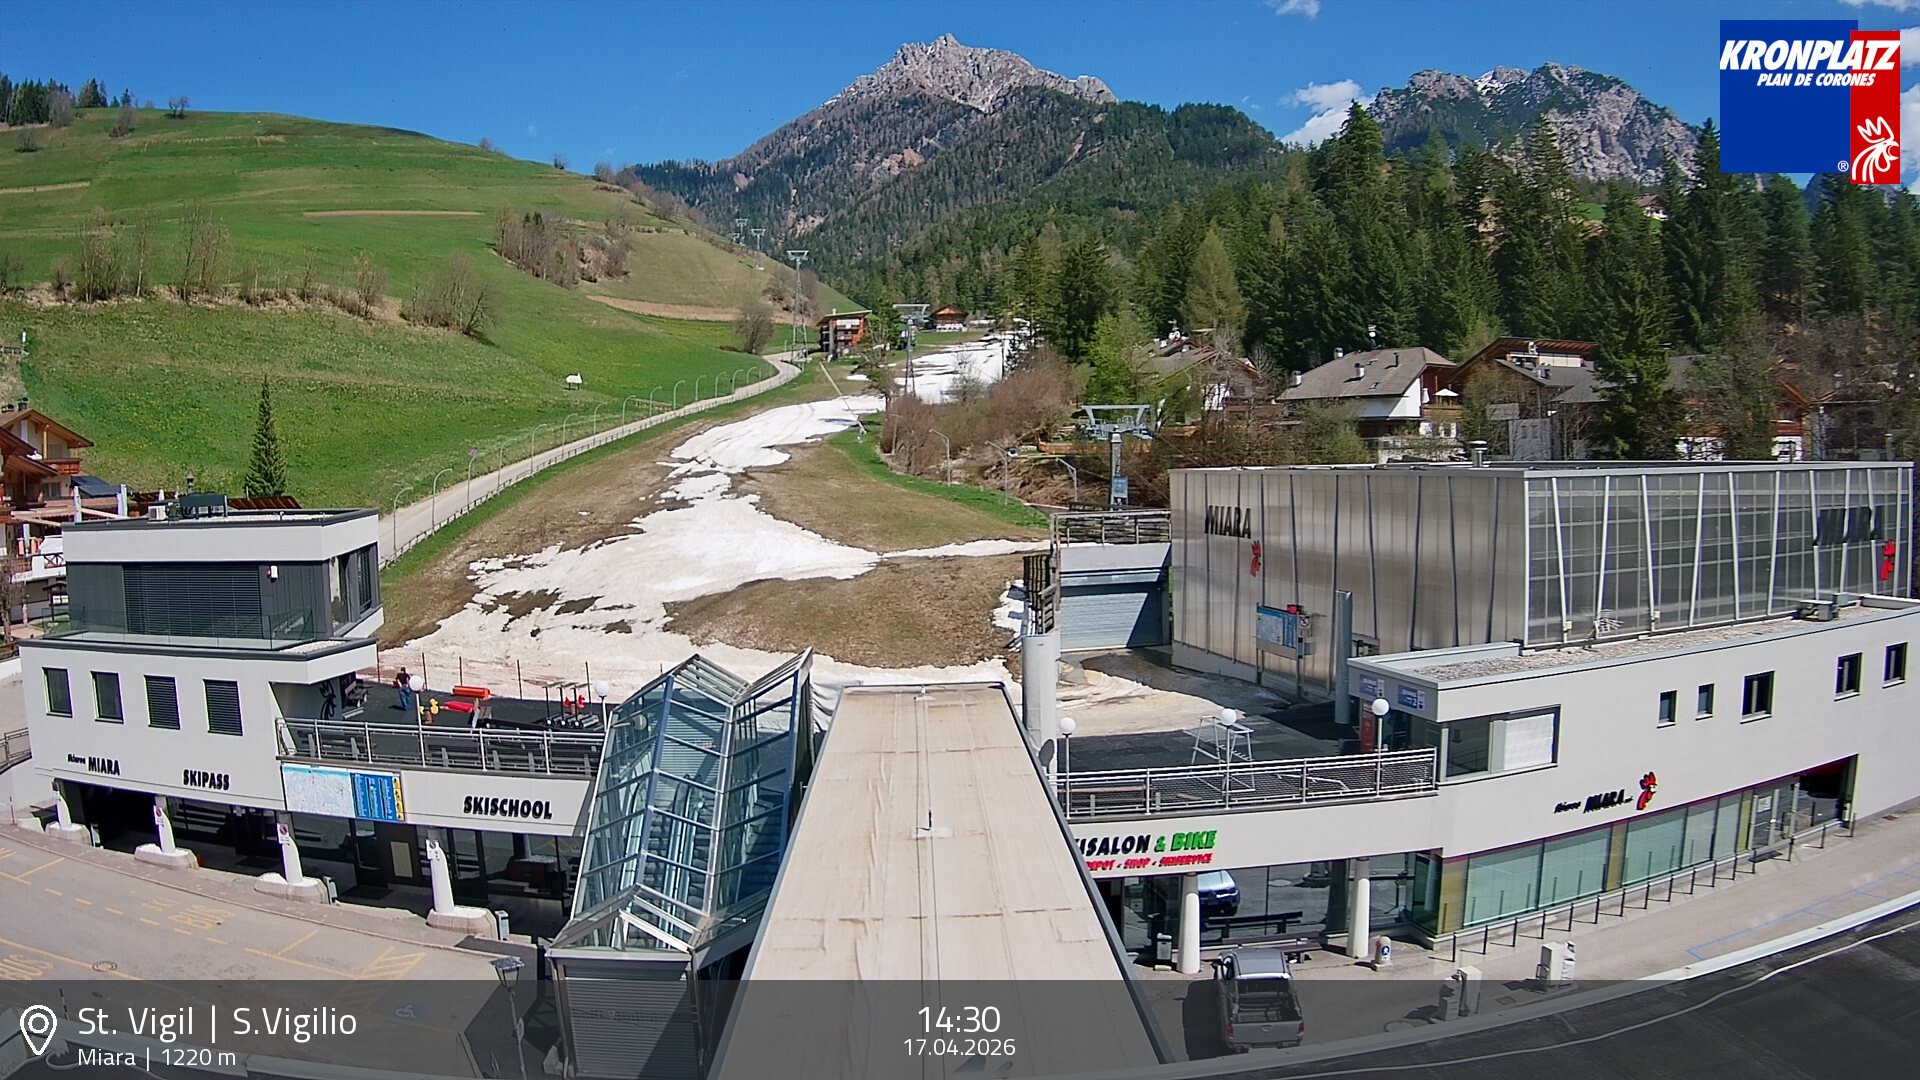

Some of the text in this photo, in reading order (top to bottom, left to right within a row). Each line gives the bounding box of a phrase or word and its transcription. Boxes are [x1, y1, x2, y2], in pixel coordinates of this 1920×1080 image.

[1204, 505, 1252, 539] MIARA
[88, 756, 120, 776] MIARA
[183, 769, 229, 790] SKIPASS
[463, 796, 552, 820] SKISCHOOL
[1583, 789, 1625, 814] MIARA
[1075, 830, 1217, 857] ISALON & BIKE
[168, 904, 236, 930] BUS
